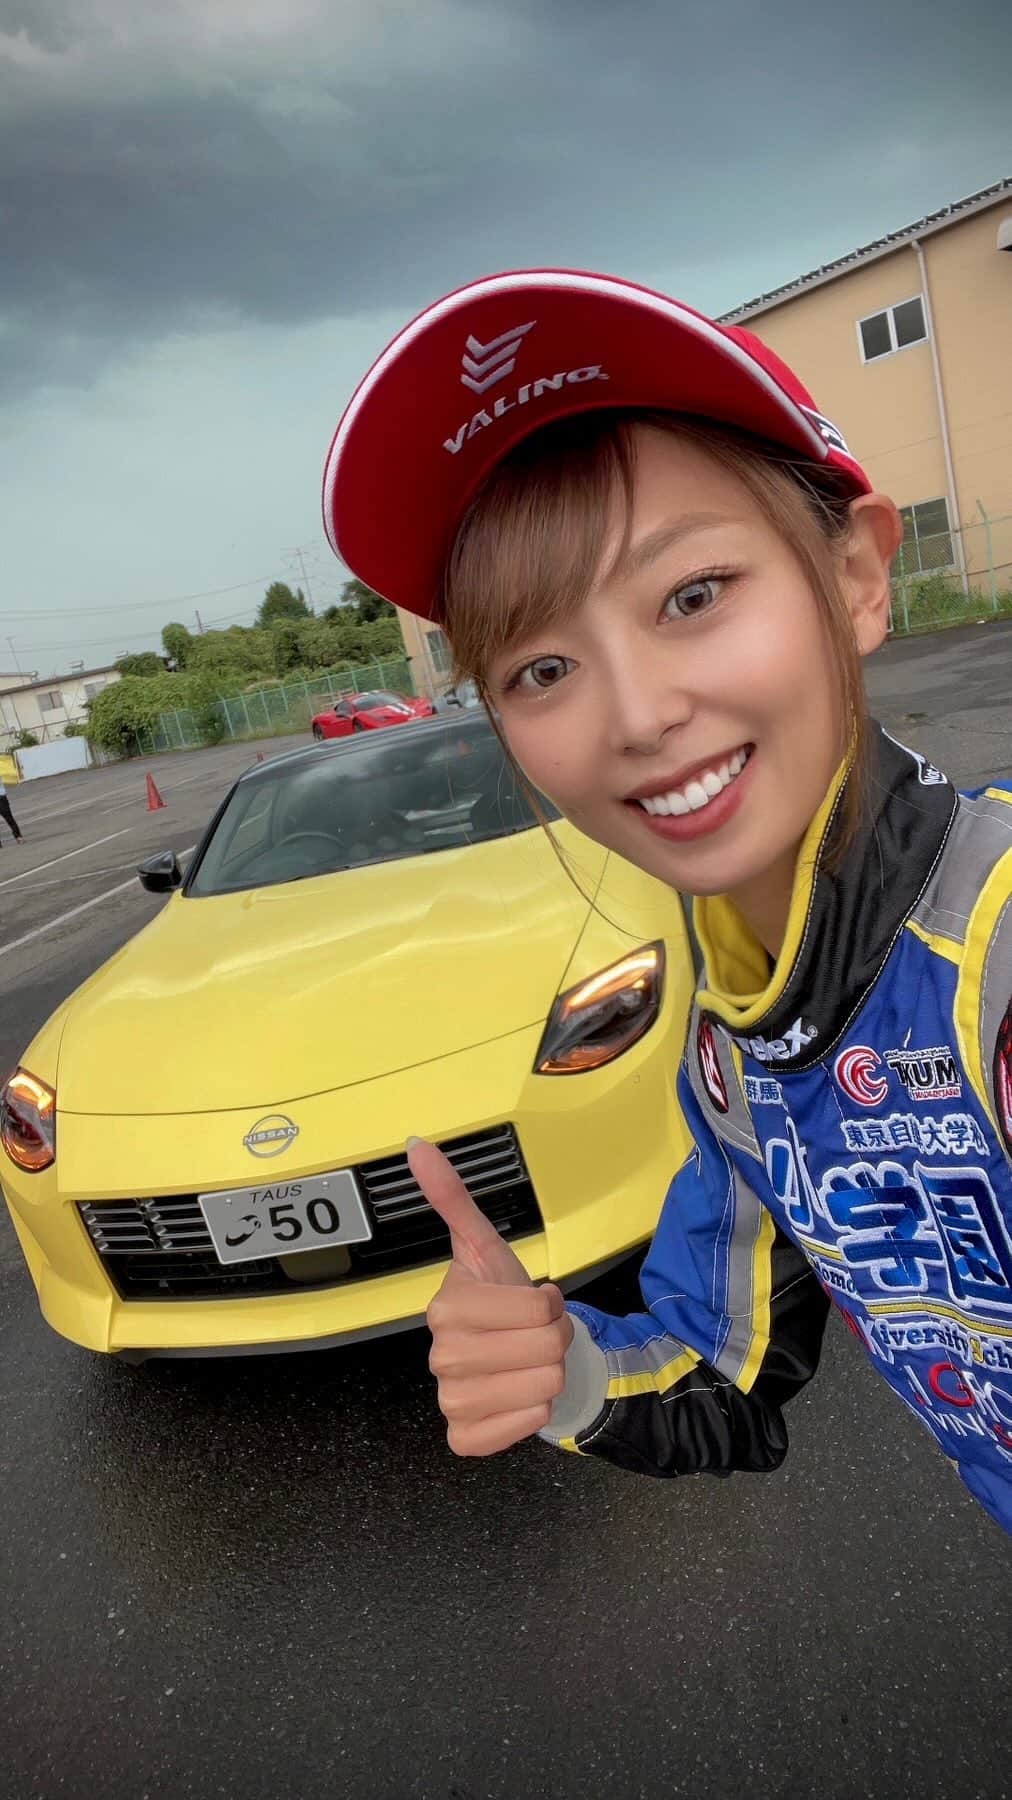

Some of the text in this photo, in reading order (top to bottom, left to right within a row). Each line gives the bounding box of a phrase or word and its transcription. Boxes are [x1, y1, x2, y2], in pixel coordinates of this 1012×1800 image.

[243, 1127, 298, 1145] NISSAN
[250, 1184, 303, 1204] TAUS
[268, 1197, 341, 1242] 50
[879, 1323, 969, 1361] iversity
